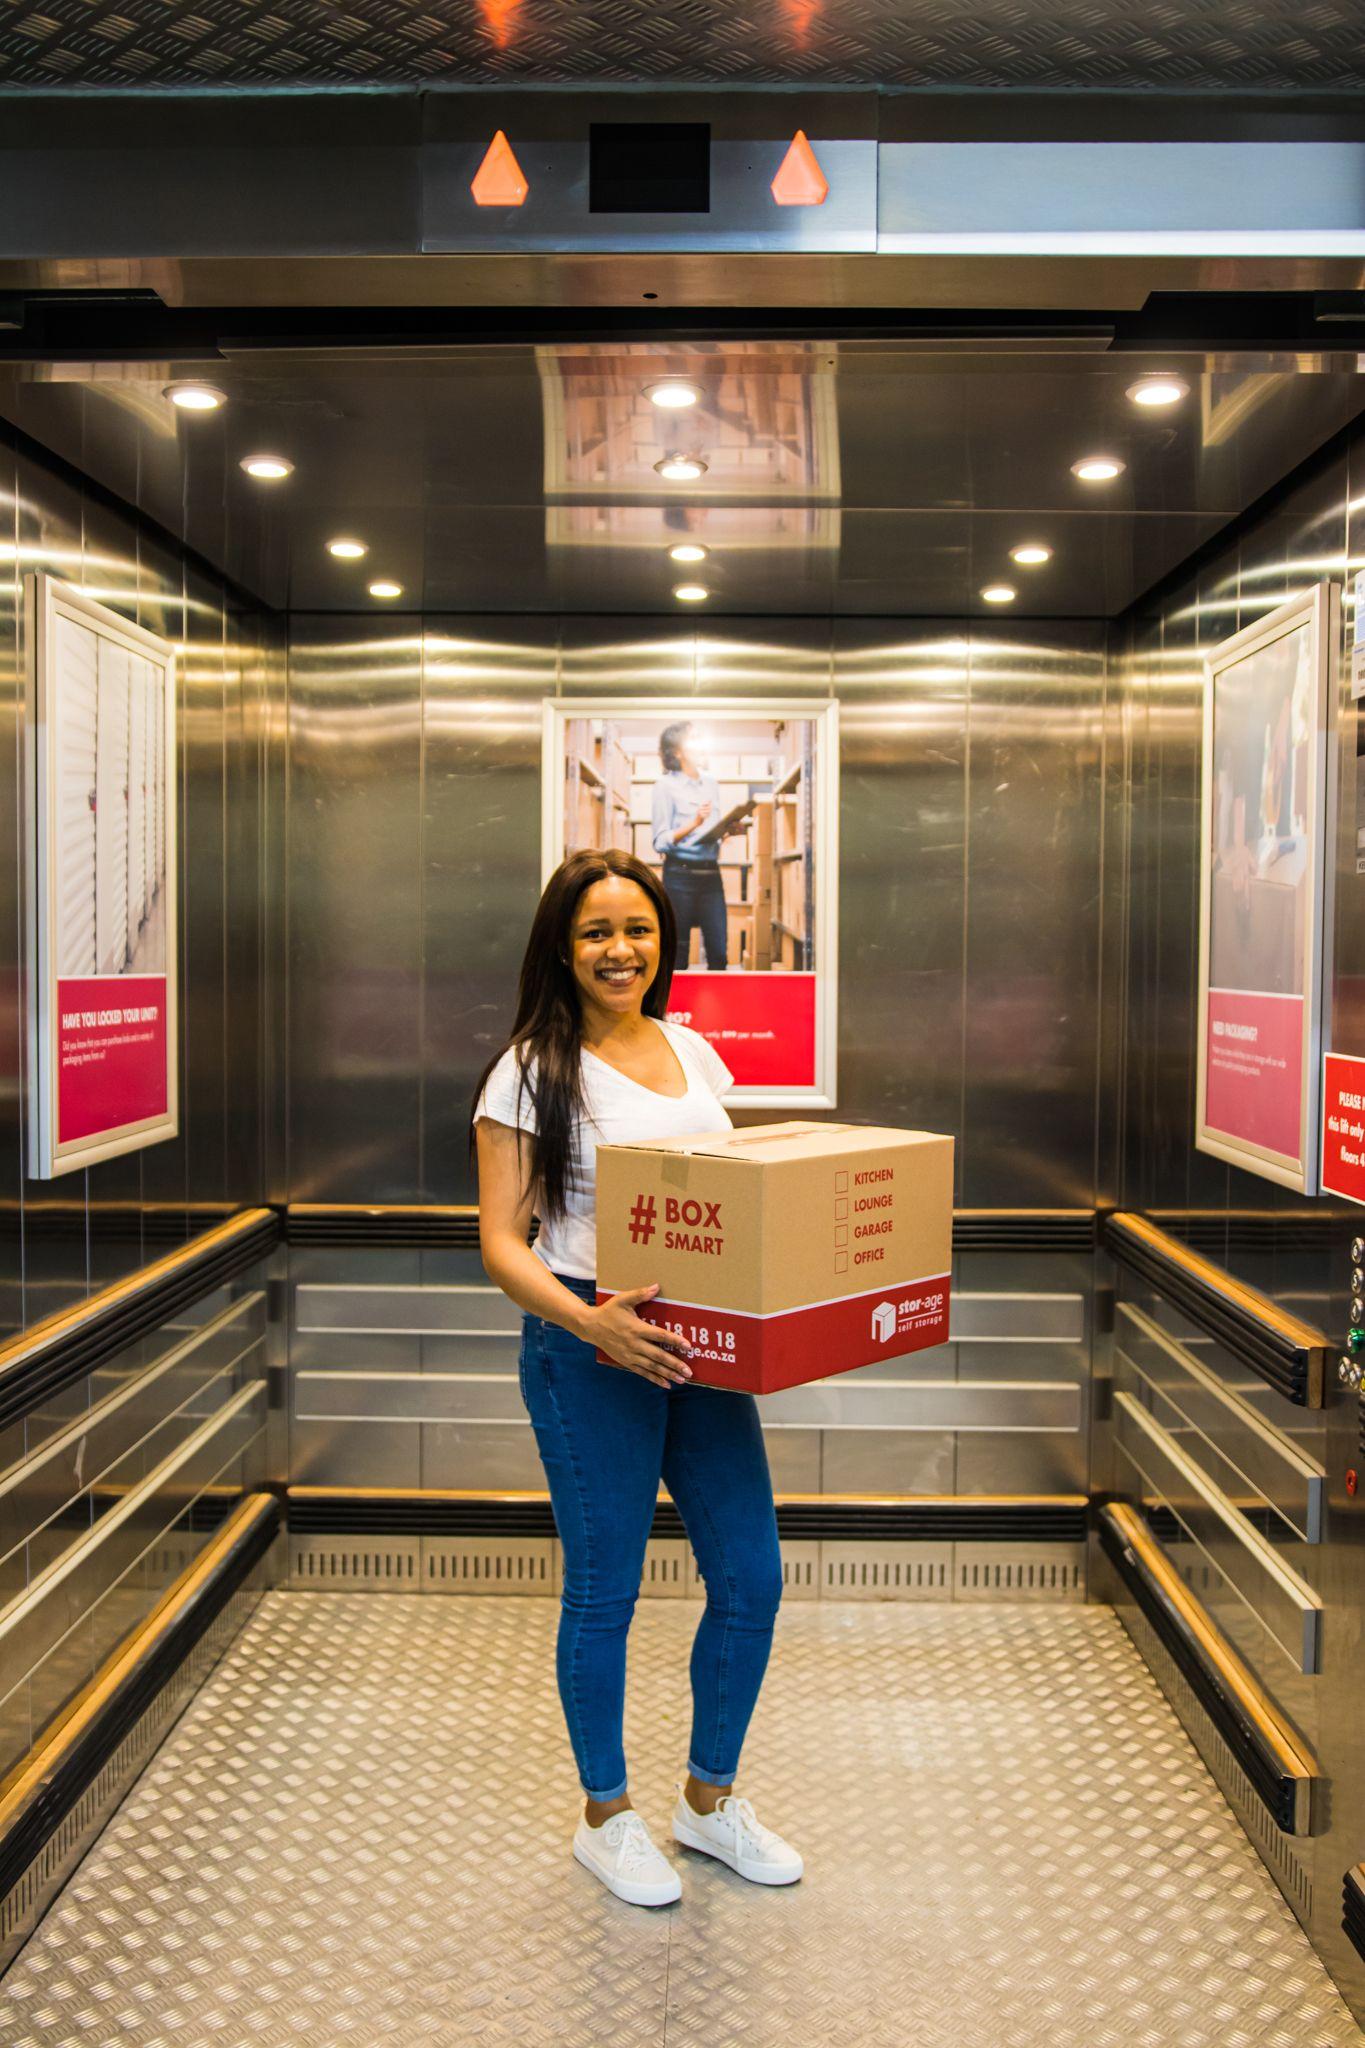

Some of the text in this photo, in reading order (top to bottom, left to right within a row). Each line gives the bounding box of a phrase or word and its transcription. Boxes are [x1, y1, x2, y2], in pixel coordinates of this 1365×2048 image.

[63, 1006, 157, 1029] HAVE YOU LOCKED YOUR UNIT?
[1339, 1091, 1362, 1110] PLEASE
[1328, 1115, 1364, 1143] this lift only
[1340, 1145, 1359, 1166] floors
[854, 1168, 894, 1186] KITCHEN
[665, 1197, 723, 1229] BOX
[854, 1194, 893, 1212] LOUNGE
[854, 1220, 893, 1239] GARAGE
[664, 1230, 724, 1256] SMART
[854, 1247, 884, 1265] OFFICE
[898, 1293, 944, 1315] stor-age
[898, 1315, 943, 1333] self storage
[690, 1326, 709, 1345] 18
[716, 1330, 735, 1350] 18
